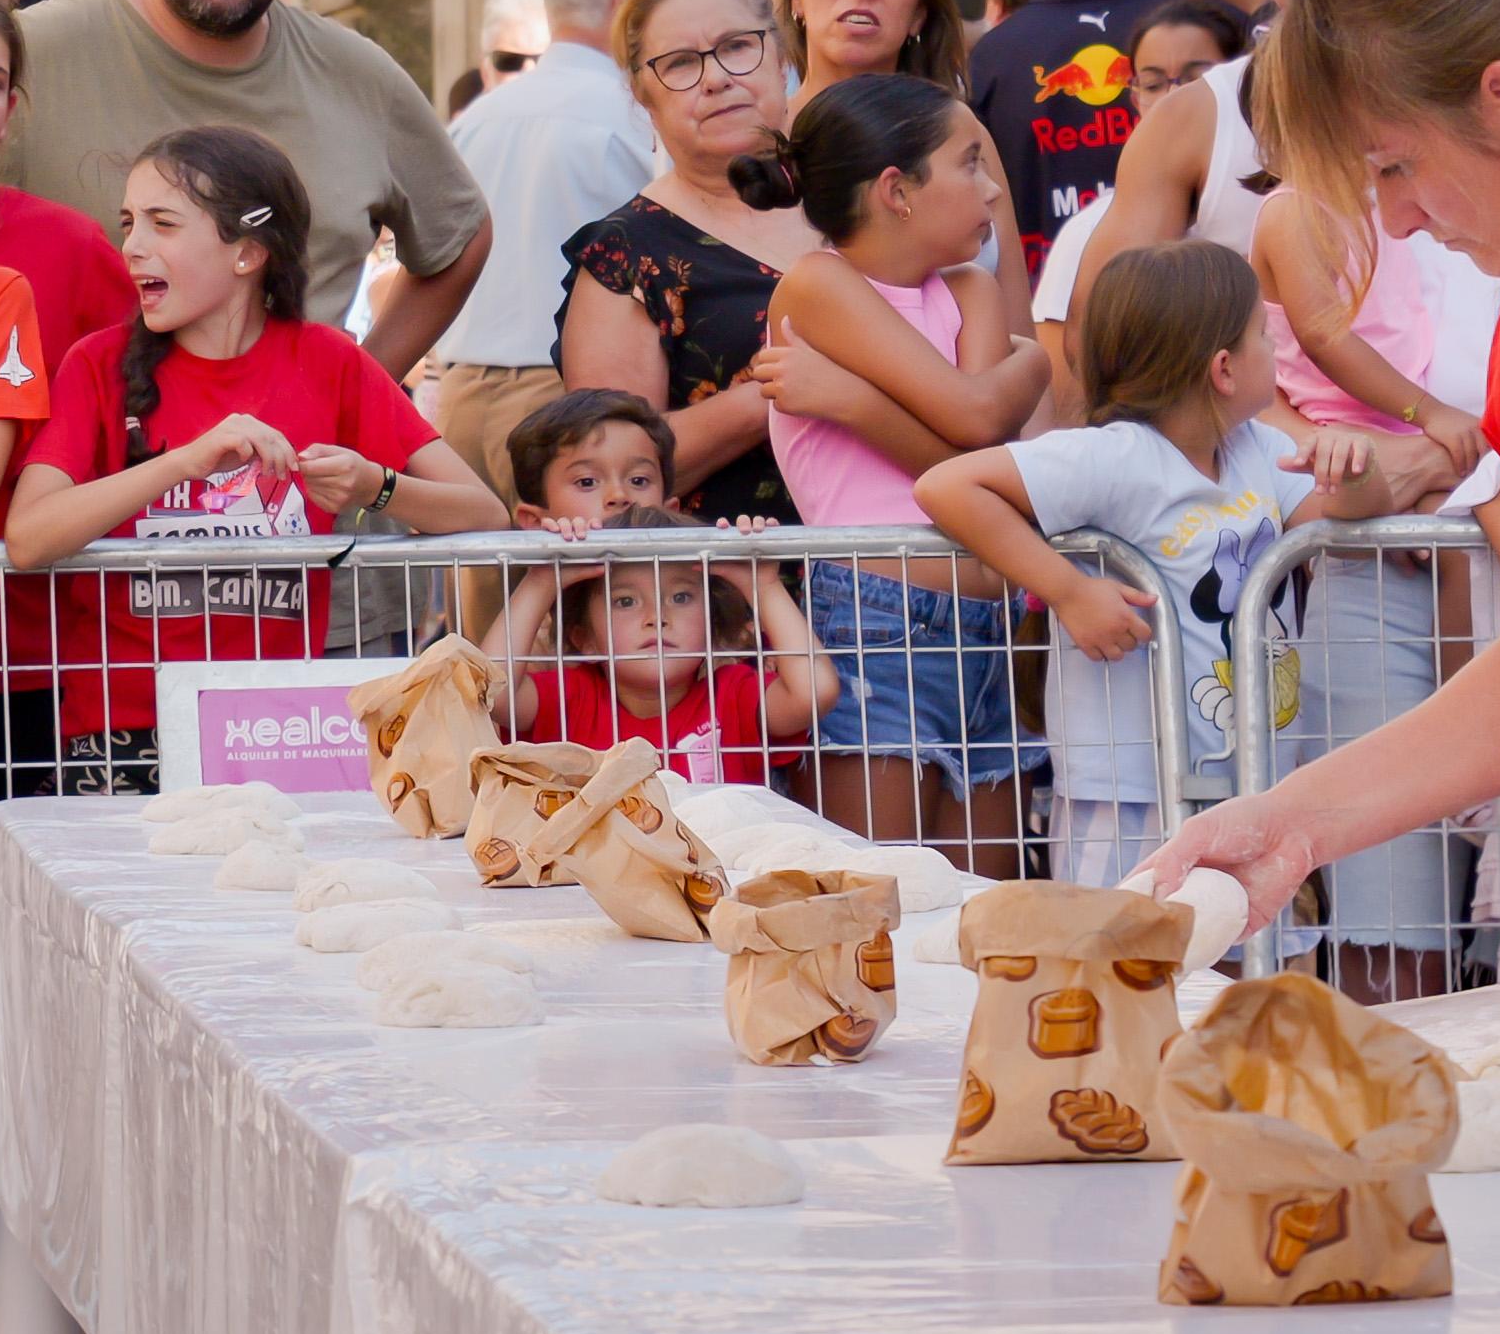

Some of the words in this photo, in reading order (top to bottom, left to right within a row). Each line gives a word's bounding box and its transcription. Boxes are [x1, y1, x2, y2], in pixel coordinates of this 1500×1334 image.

[1031, 107, 1140, 154] RedB
[134, 578, 191, 608] BM.
[226, 750, 279, 762] ALQUILER
[284, 751, 301, 760] DE
